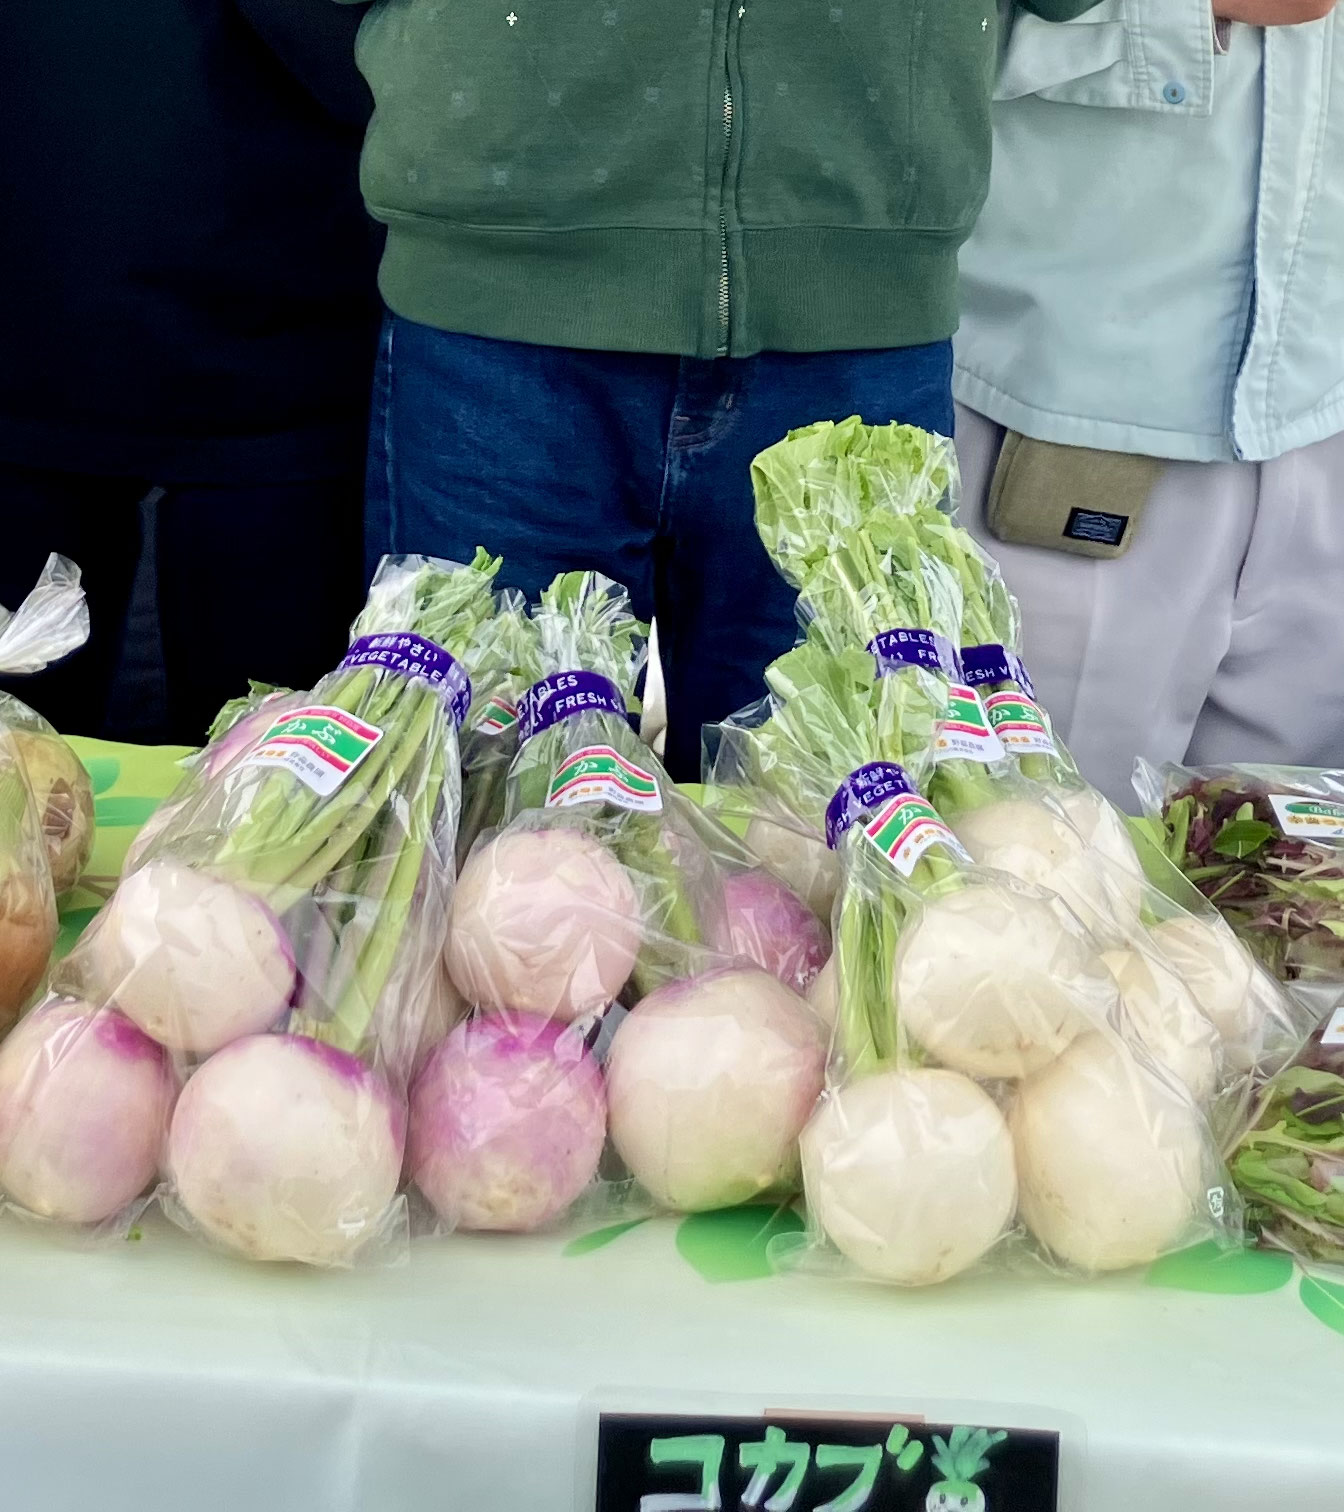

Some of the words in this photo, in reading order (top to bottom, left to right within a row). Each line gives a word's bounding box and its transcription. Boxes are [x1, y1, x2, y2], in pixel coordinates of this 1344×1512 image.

[555, 691, 607, 714] FRESH
[280, 719, 342, 745] かぶ
[640, 1423, 925, 1512] コカブ
